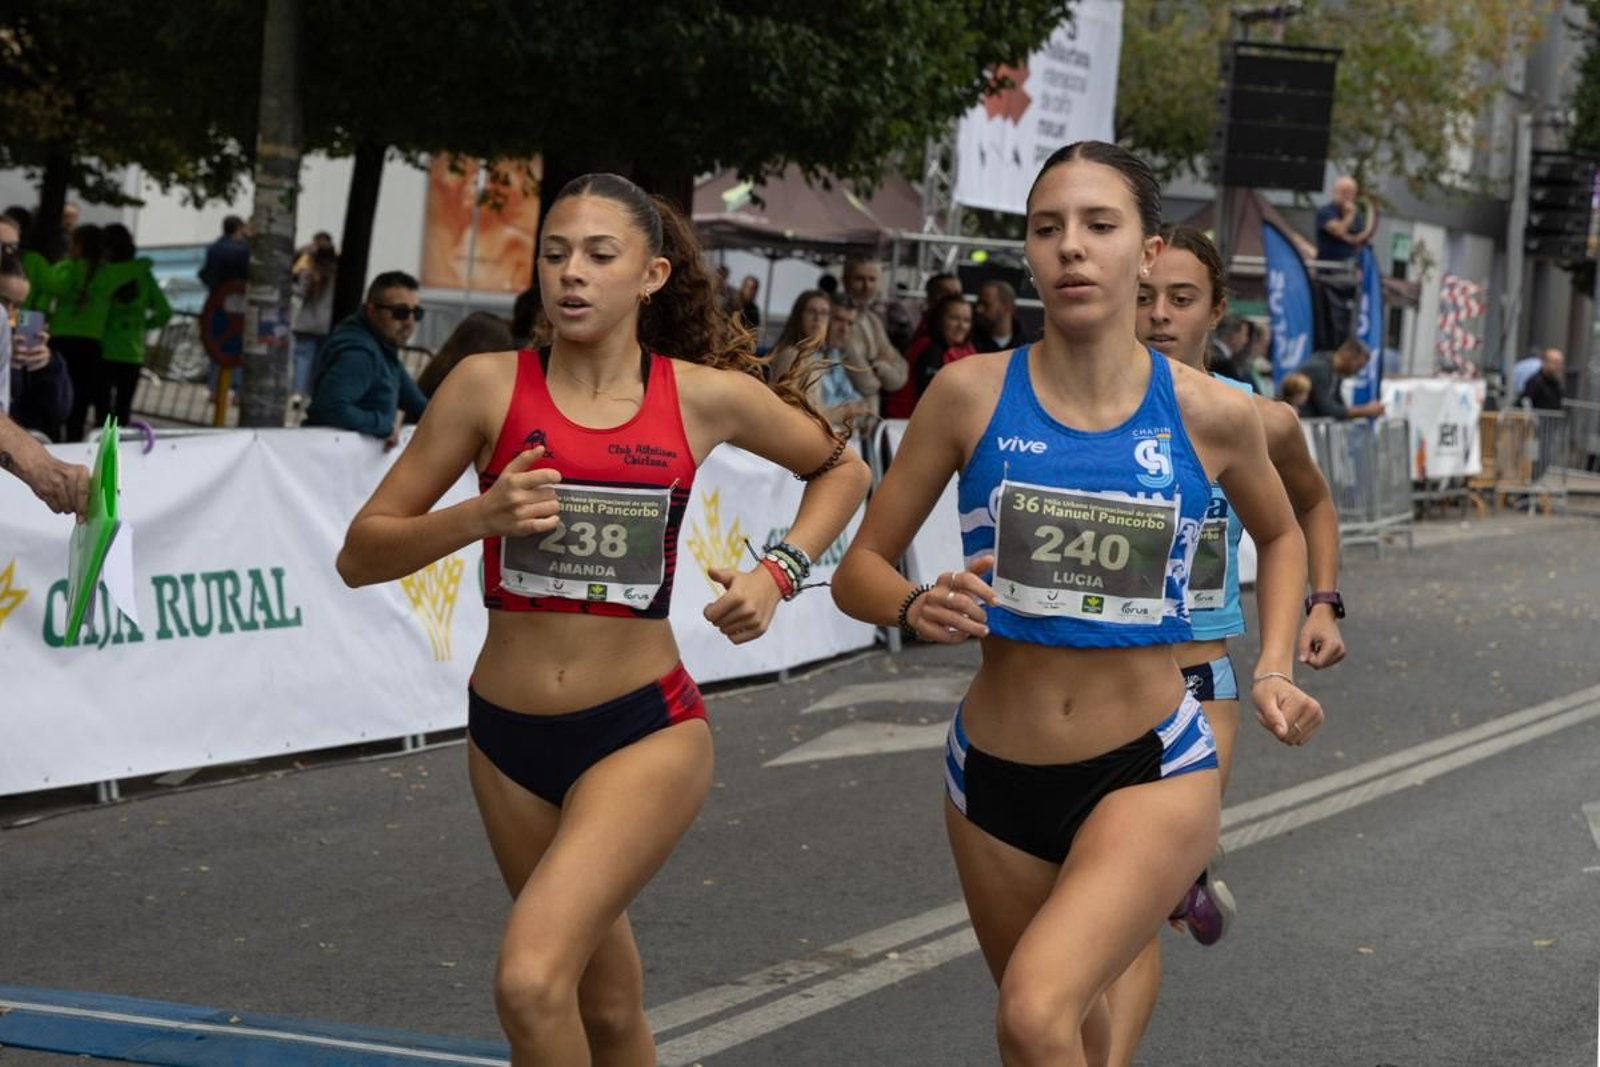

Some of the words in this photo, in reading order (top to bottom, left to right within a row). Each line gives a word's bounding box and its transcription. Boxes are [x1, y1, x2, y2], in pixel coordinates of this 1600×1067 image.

[997, 436, 1047, 454] vive
[558, 502, 594, 514] anuel
[597, 504, 659, 518] Pancorbo
[1012, 493, 1039, 513] 36
[1063, 500, 1088, 509] Urbana
[1089, 503, 1134, 515] Internacional
[1043, 504, 1094, 521] Manuel
[1099, 511, 1166, 530] Pancorbo
[538, 521, 628, 558] 238
[1031, 525, 1130, 571] 240
[549, 560, 616, 577] AMANDA
[1053, 571, 1104, 588] LUCIA
[151, 567, 303, 640] RURAL
